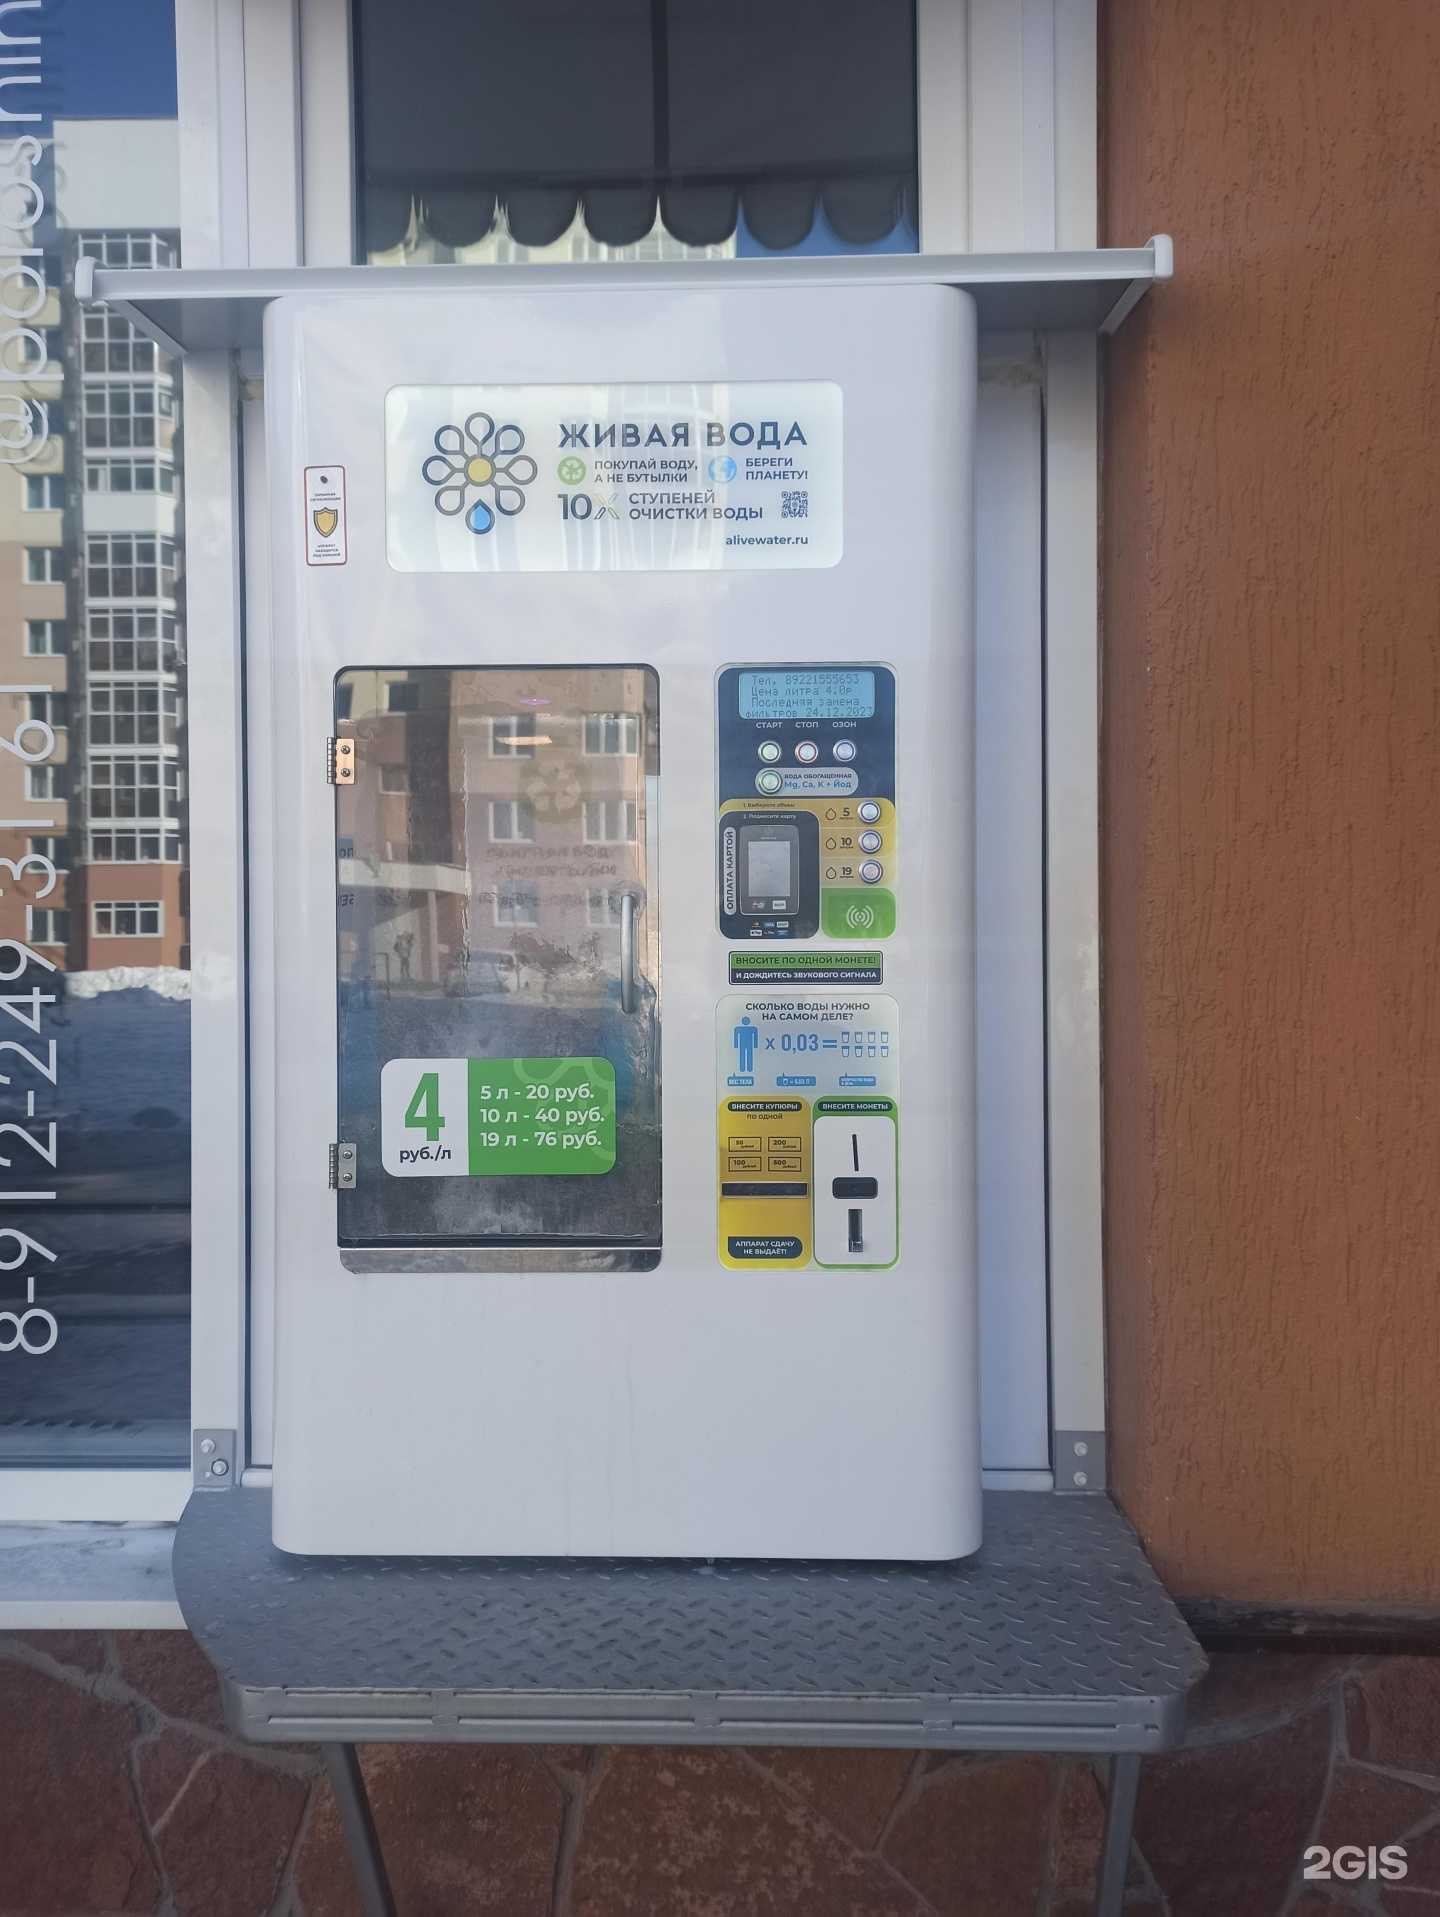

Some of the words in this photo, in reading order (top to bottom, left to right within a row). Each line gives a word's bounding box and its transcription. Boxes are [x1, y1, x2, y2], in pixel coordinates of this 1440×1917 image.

[558, 422, 689, 448] ЖИВАЯ
[706, 421, 808, 450] ВОДА
[594, 458, 656, 471] ПОКУПАЙ
[660, 459, 698, 473] ВОДУ,
[745, 457, 793, 467] БЕРЕГИ
[606, 474, 623, 483] НЕ
[626, 472, 688, 483] БУТЫЛКИ
[745, 470, 808, 481] ПЛАНЕТУ!
[628, 489, 715, 505] СТУПЕНЕЙ
[628, 507, 708, 520] ОЧИСТКИ
[712, 507, 763, 520] ВОДЫ
[725, 533, 809, 546] alivewater.ru
[755, 721, 783, 729] СТАРТ
[795, 721, 819, 729] СТОП
[843, 807, 850, 816] 5
[841, 837, 852, 846] 10
[724, 831, 734, 869] КАРТОЙ
[842, 867, 852, 875] 19
[726, 870, 734, 910] ОПЛАТА
[735, 956, 779, 965] ВНОСИТЕ
[782, 956, 796, 964] ПО
[799, 955, 833, 966] ОДНОЙ
[835, 955, 876, 964] МОНЕТЕ!
[743, 972, 792, 980] ДОЖДИТЕСЬ
[745, 1002, 795, 1011] СКОЛЬКО
[797, 1002, 828, 1012] ВОДЫ
[831, 1002, 871, 1011] НУЖНО
[762, 1013, 777, 1021] НА
[779, 1012, 819, 1021] САМОМ
[820, 1012, 854, 1022] ДЕЛЕ?
[480, 1085, 491, 1099] 5
[496, 1087, 509, 1099] л
[526, 1084, 550, 1099] 20
[555, 1083, 595, 1103] руб.
[404, 1072, 446, 1142] 4
[479, 1108, 500, 1123] 10
[505, 1111, 518, 1123] л
[534, 1107, 561, 1122] 40
[565, 1106, 605, 1126] руб.
[479, 1132, 500, 1147] 19
[504, 1134, 517, 1146] л
[534, 1131, 558, 1146] 76
[562, 1129, 602, 1149] руб.
[400, 1145, 451, 1164] руб./л
[770, 1240, 795, 1248] СДАЧУ
